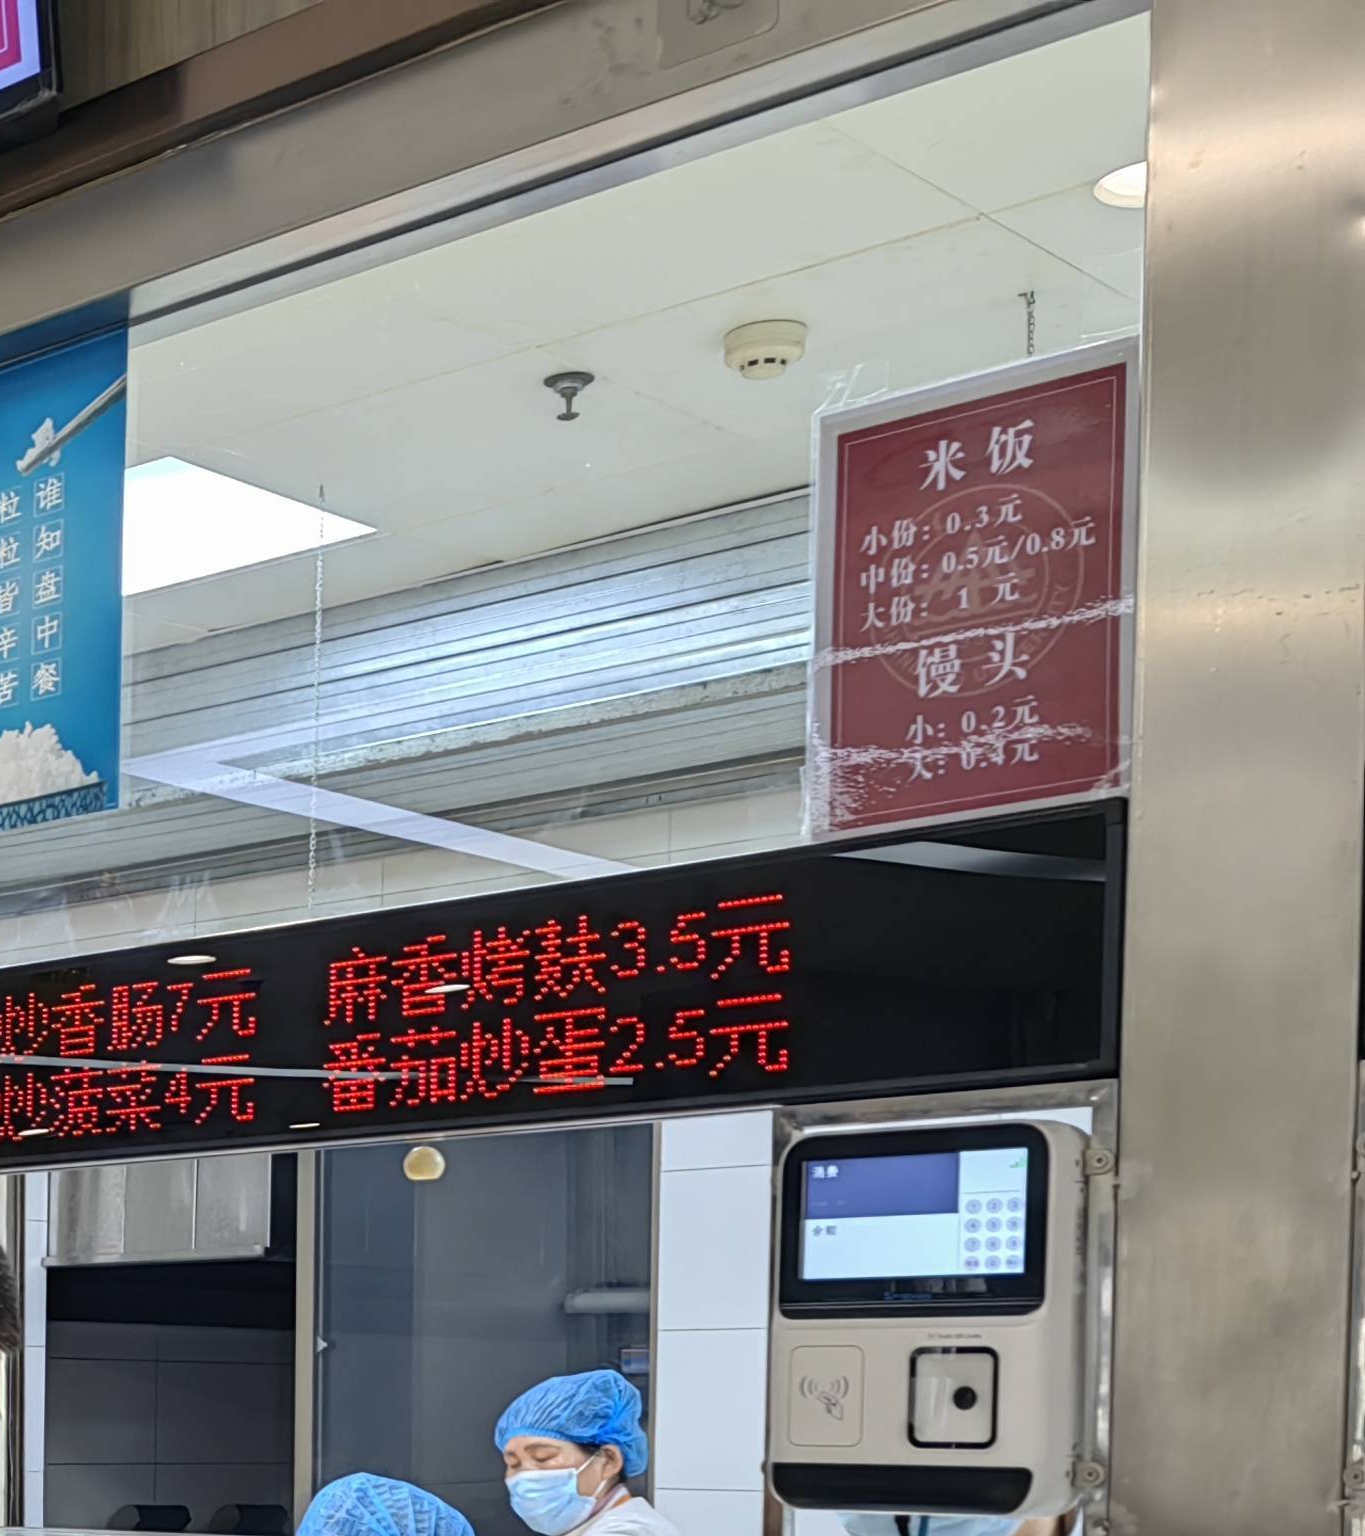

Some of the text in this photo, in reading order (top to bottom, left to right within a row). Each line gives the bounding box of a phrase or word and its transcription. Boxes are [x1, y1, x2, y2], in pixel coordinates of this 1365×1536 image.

[920, 419, 1037, 491] 米饭
[32, 478, 63, 694] 谁知盘中餐
[917, 630, 1031, 698] 馒头
[322, 992, 789, 1113] 番茄炒蛋2.5元
